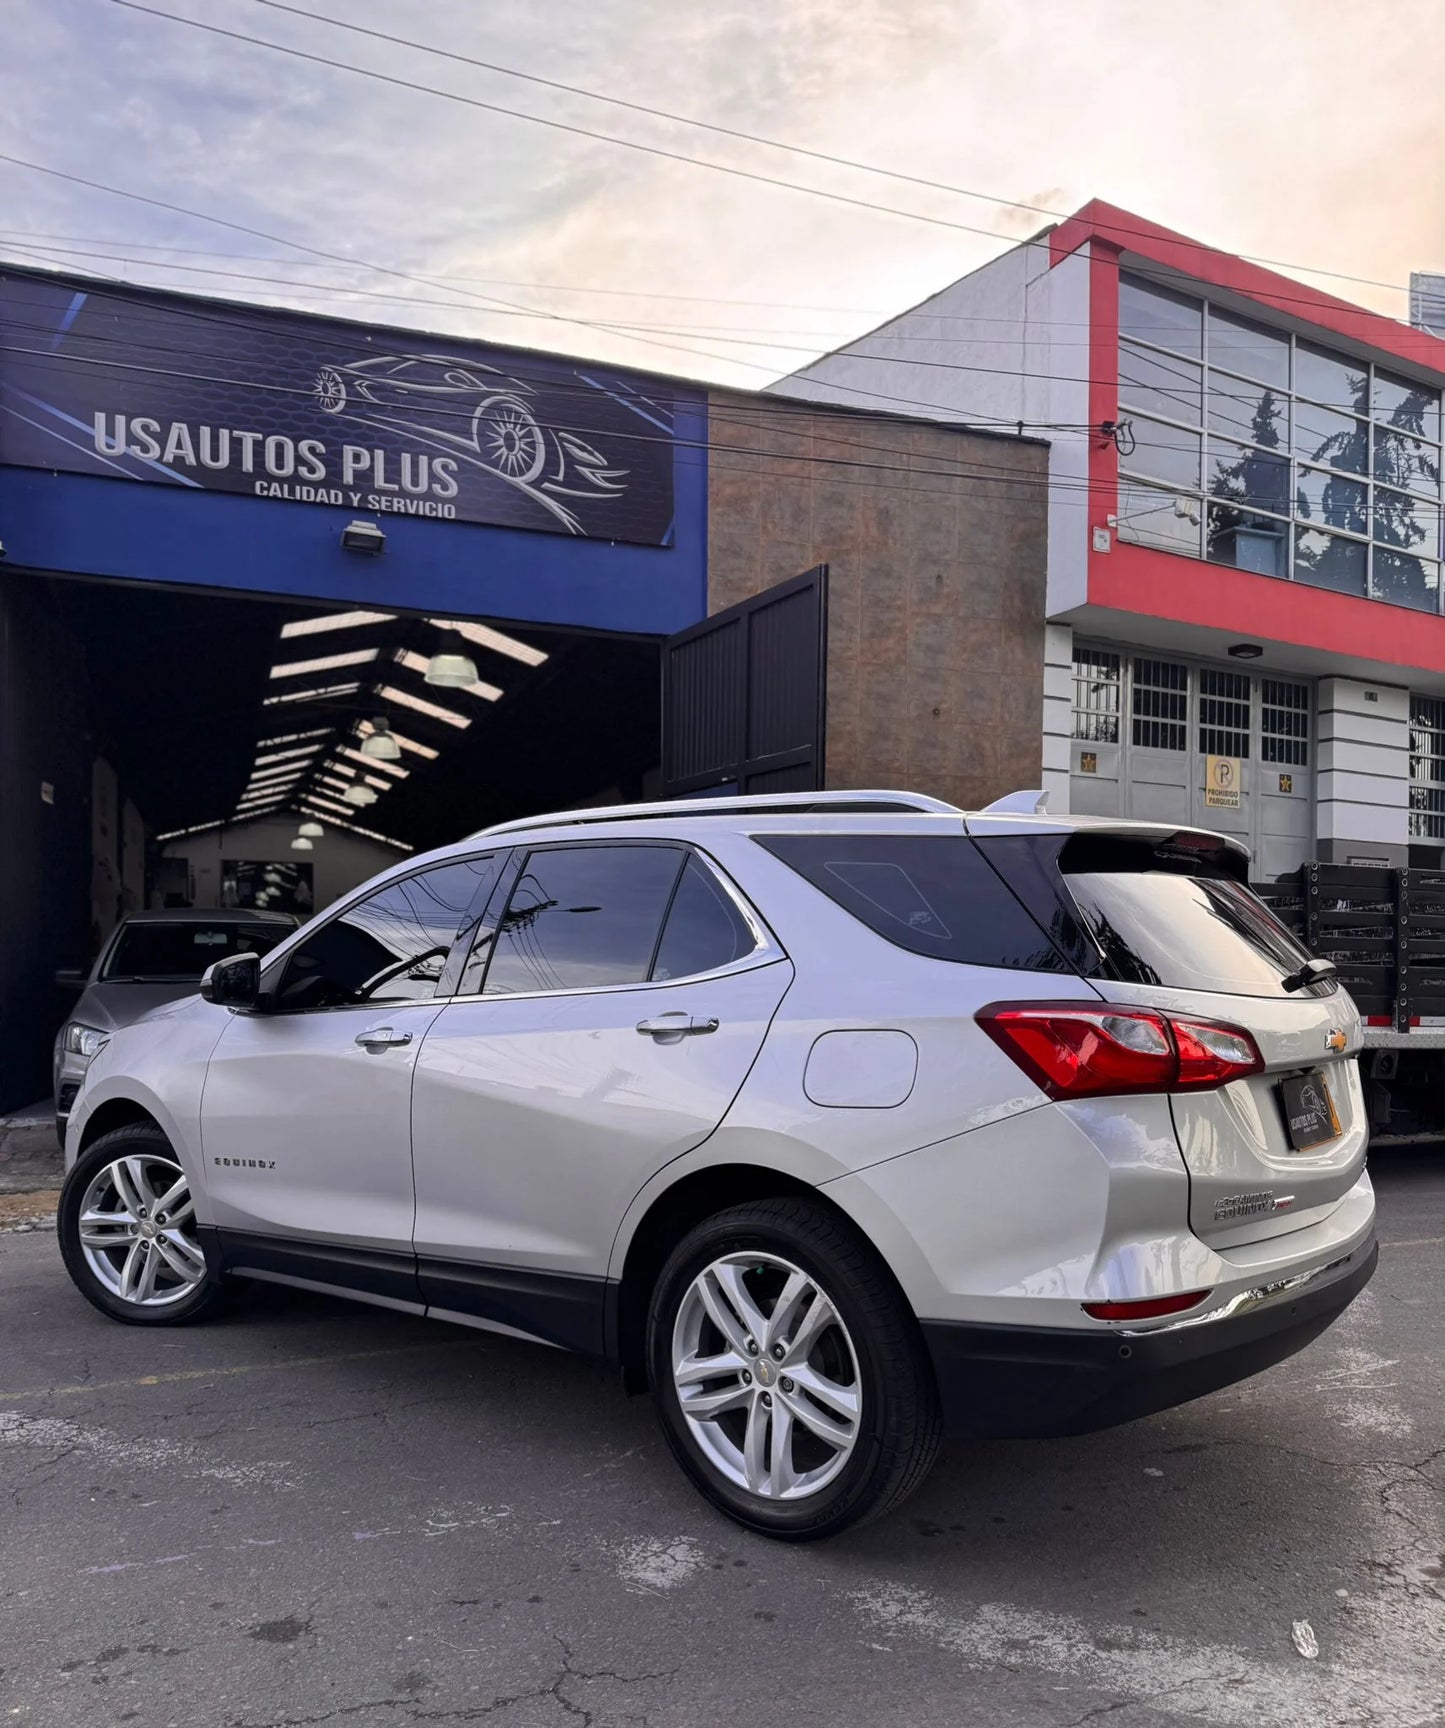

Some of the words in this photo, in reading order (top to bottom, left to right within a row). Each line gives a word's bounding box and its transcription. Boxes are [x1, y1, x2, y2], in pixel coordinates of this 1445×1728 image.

[94, 411, 327, 483] USAUTOS
[342, 444, 459, 499] PLUS
[254, 480, 343, 506] CALIDAD
[348, 492, 361, 508] Y
[367, 494, 456, 520] SERVICIO
[1208, 796, 1239, 806] PARQUEAR
